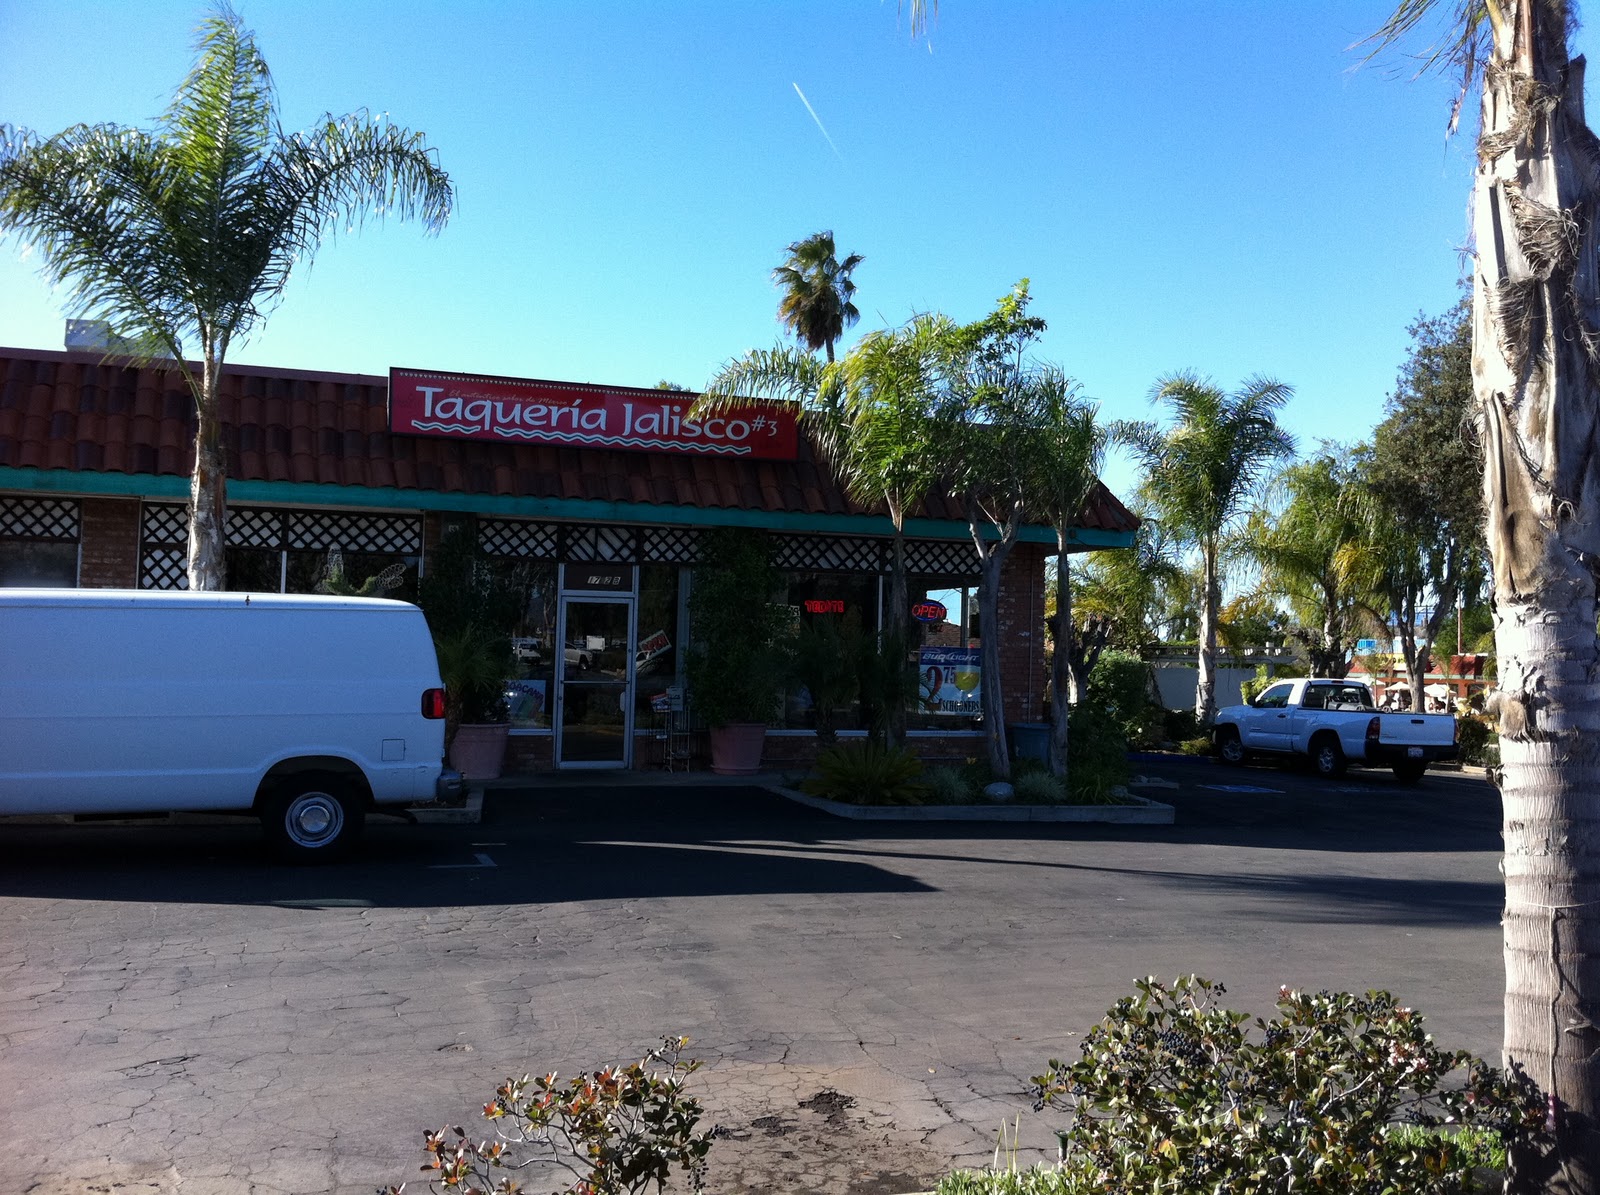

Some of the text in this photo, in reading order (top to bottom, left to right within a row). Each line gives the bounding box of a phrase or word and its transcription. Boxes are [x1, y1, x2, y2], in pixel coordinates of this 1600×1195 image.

[415, 385, 778, 440] Taquería Jalisco #3
[911, 603, 947, 619] OPEN
[942, 700, 980, 712] SCHOONERS
